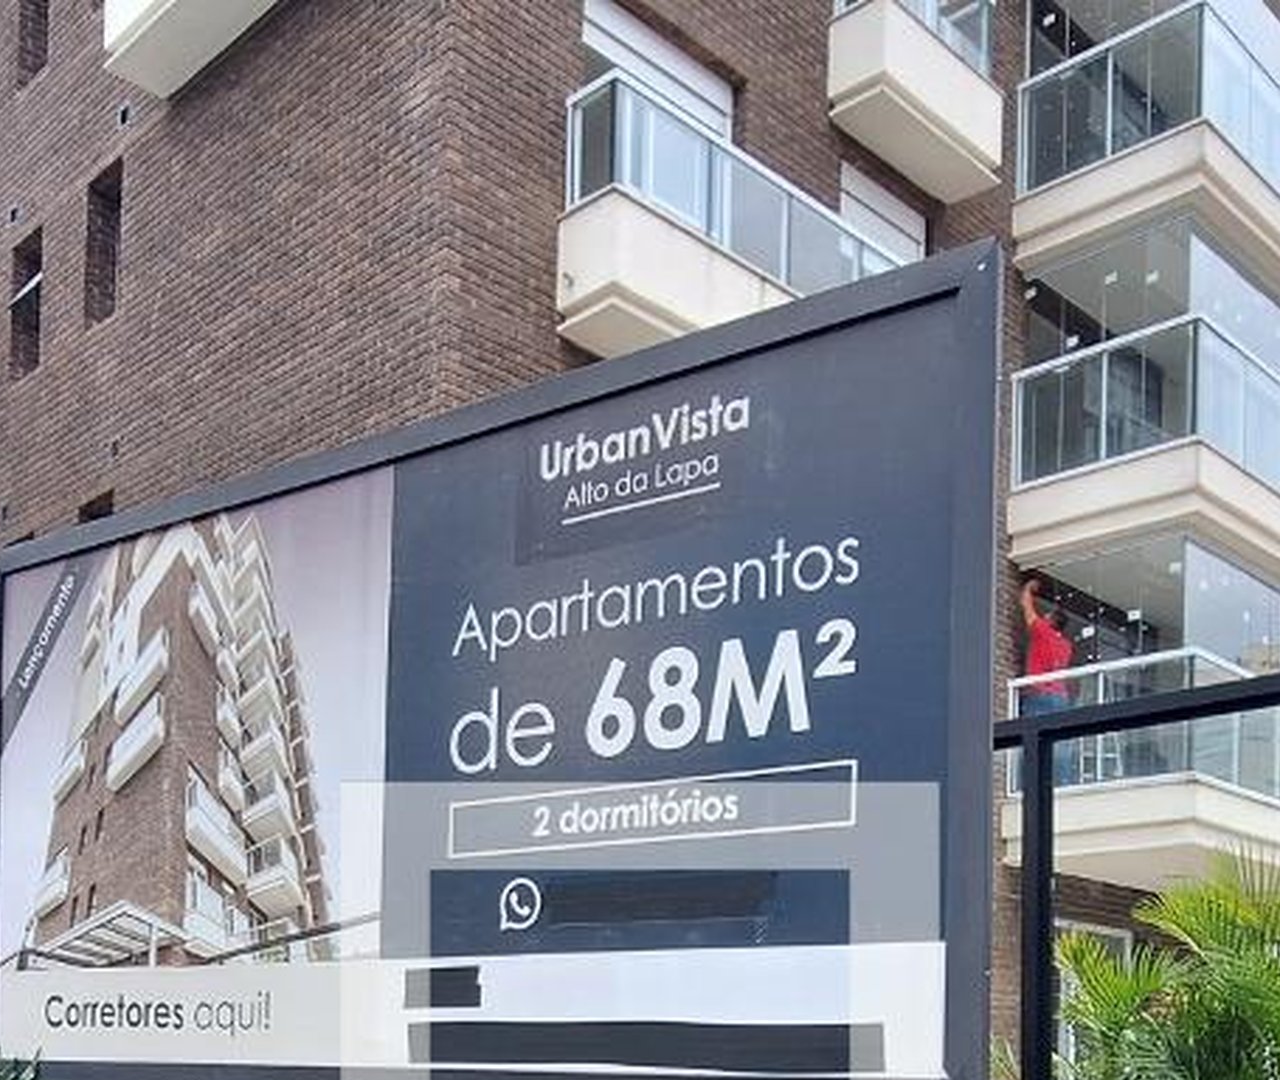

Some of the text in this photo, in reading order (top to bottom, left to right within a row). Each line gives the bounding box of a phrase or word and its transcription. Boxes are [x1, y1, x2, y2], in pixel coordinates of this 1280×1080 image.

[539, 395, 751, 481] UrbanVista
[564, 453, 720, 511] Alto da Lapa
[451, 535, 861, 664] Apartamentos
[448, 685, 557, 775] de
[531, 788, 740, 837] 2 dormitórios
[43, 990, 273, 1036] Corretores aqui!
